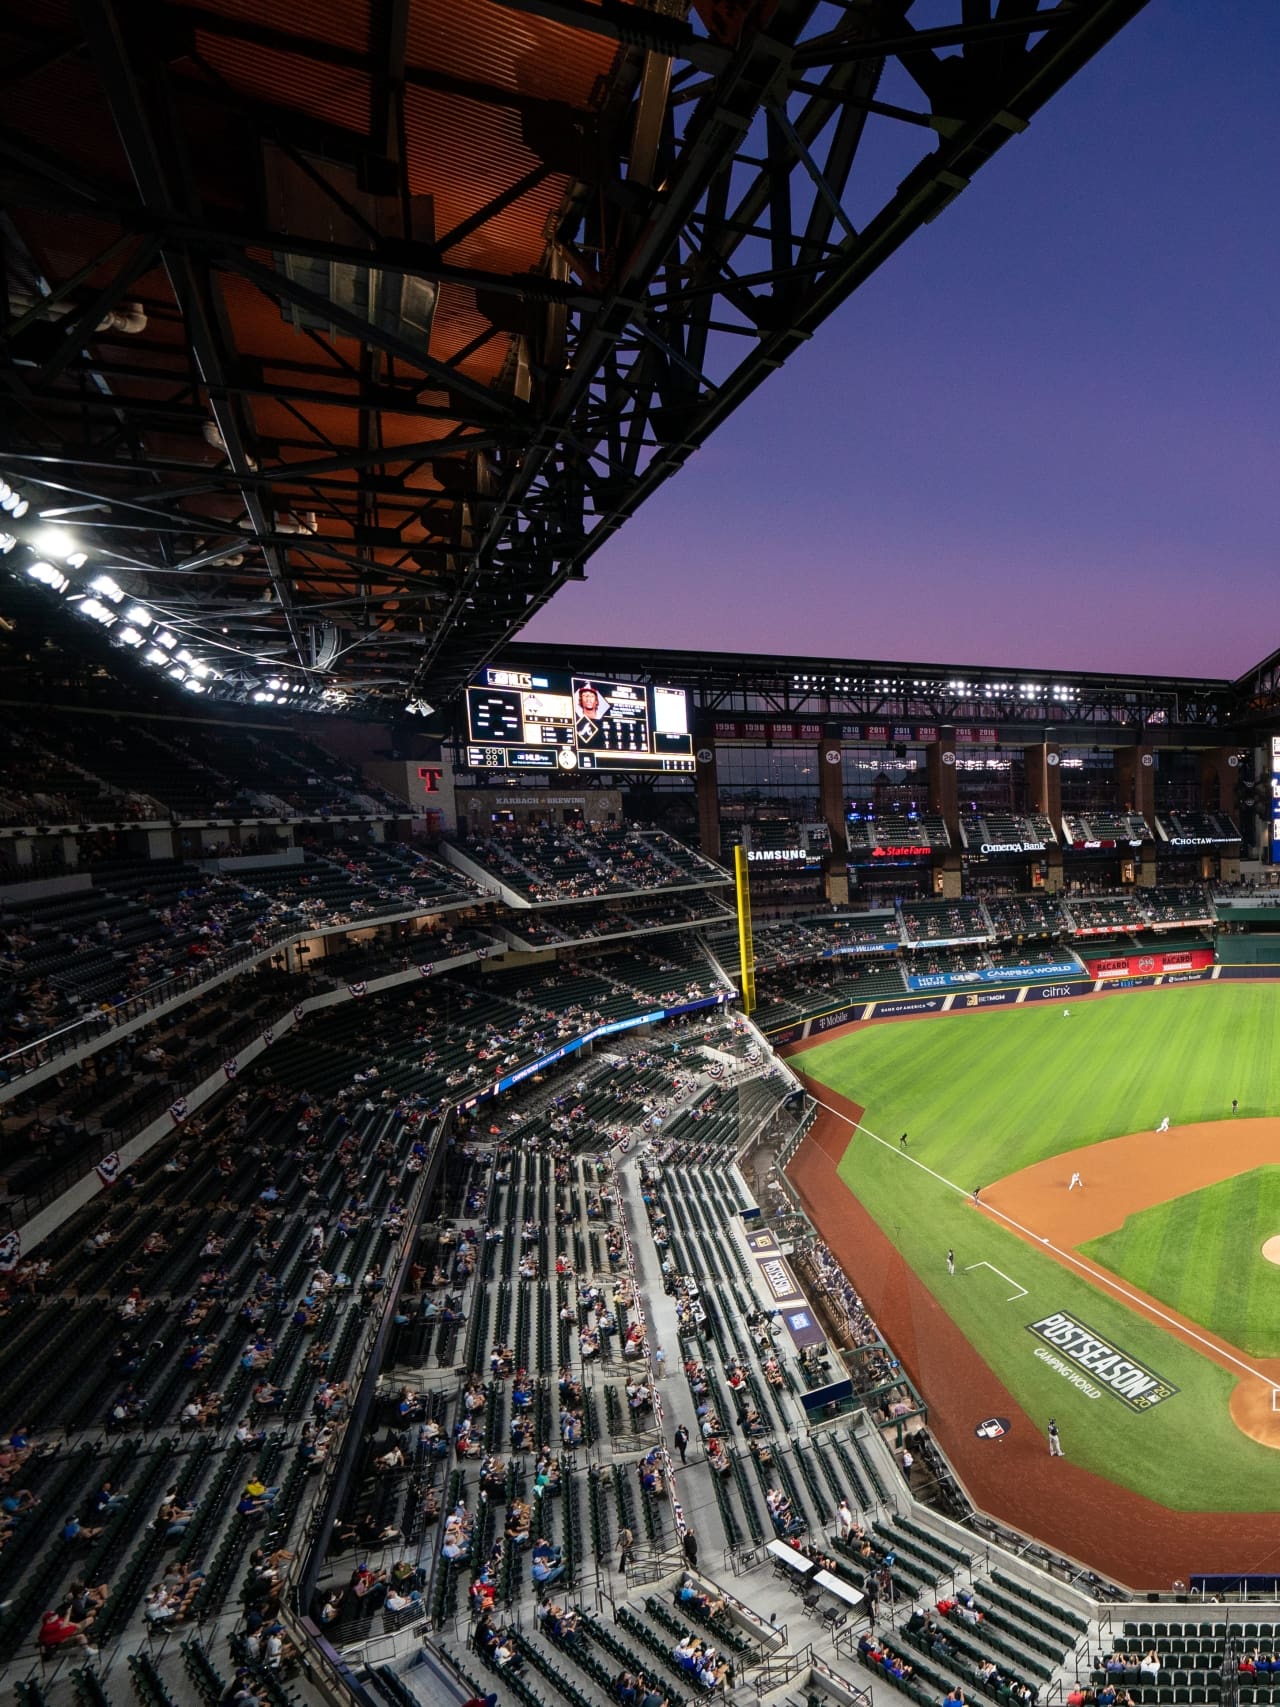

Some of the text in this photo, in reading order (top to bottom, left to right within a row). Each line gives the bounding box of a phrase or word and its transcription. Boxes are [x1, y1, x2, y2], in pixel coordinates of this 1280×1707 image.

[699, 752, 711, 761] 42
[828, 753, 839, 761] 34
[418, 767, 443, 793] T
[1024, 841, 1046, 851] Bank
[748, 850, 806, 861] SAMSUNG
[987, 963, 1071, 977] CAMPING WORLD
[827, 1012, 848, 1027] Mobile
[1033, 1313, 1158, 1399] POSTSEASON
[1034, 1348, 1102, 1399] CAMPING WORLD
[1154, 1385, 1171, 1398] 20
[1133, 1397, 1152, 1408] 20
